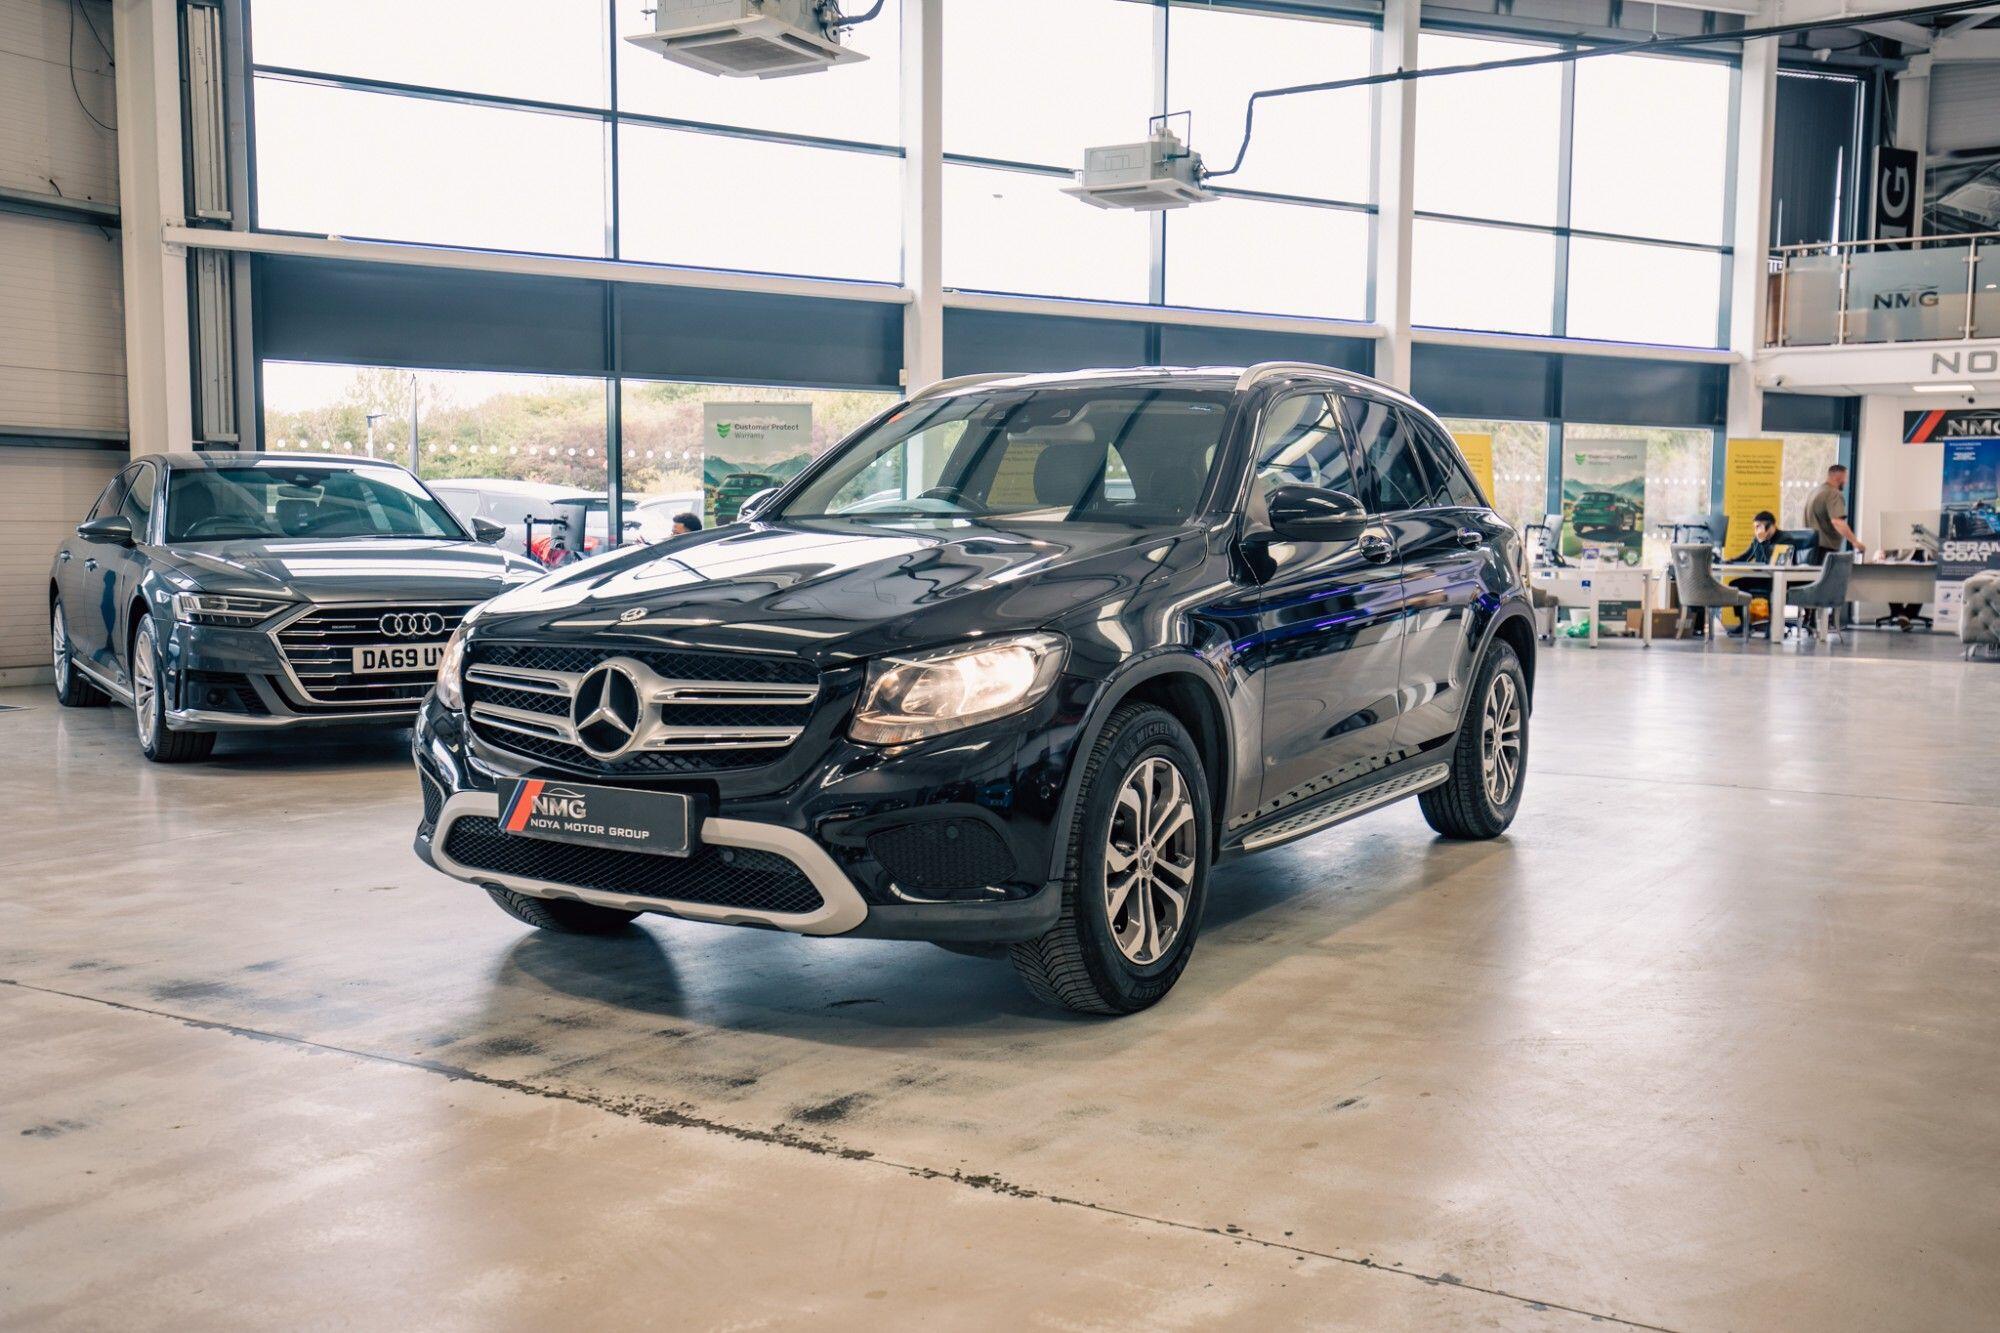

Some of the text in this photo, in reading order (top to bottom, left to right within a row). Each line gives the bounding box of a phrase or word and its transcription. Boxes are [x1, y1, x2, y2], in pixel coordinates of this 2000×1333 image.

[1873, 291, 1939, 310] NMG
[1943, 551, 1992, 562] COAT
[362, 649, 418, 668] DA69
[531, 796, 587, 819] NMG
[530, 818, 650, 840] NOYA MOTOR GROUP
